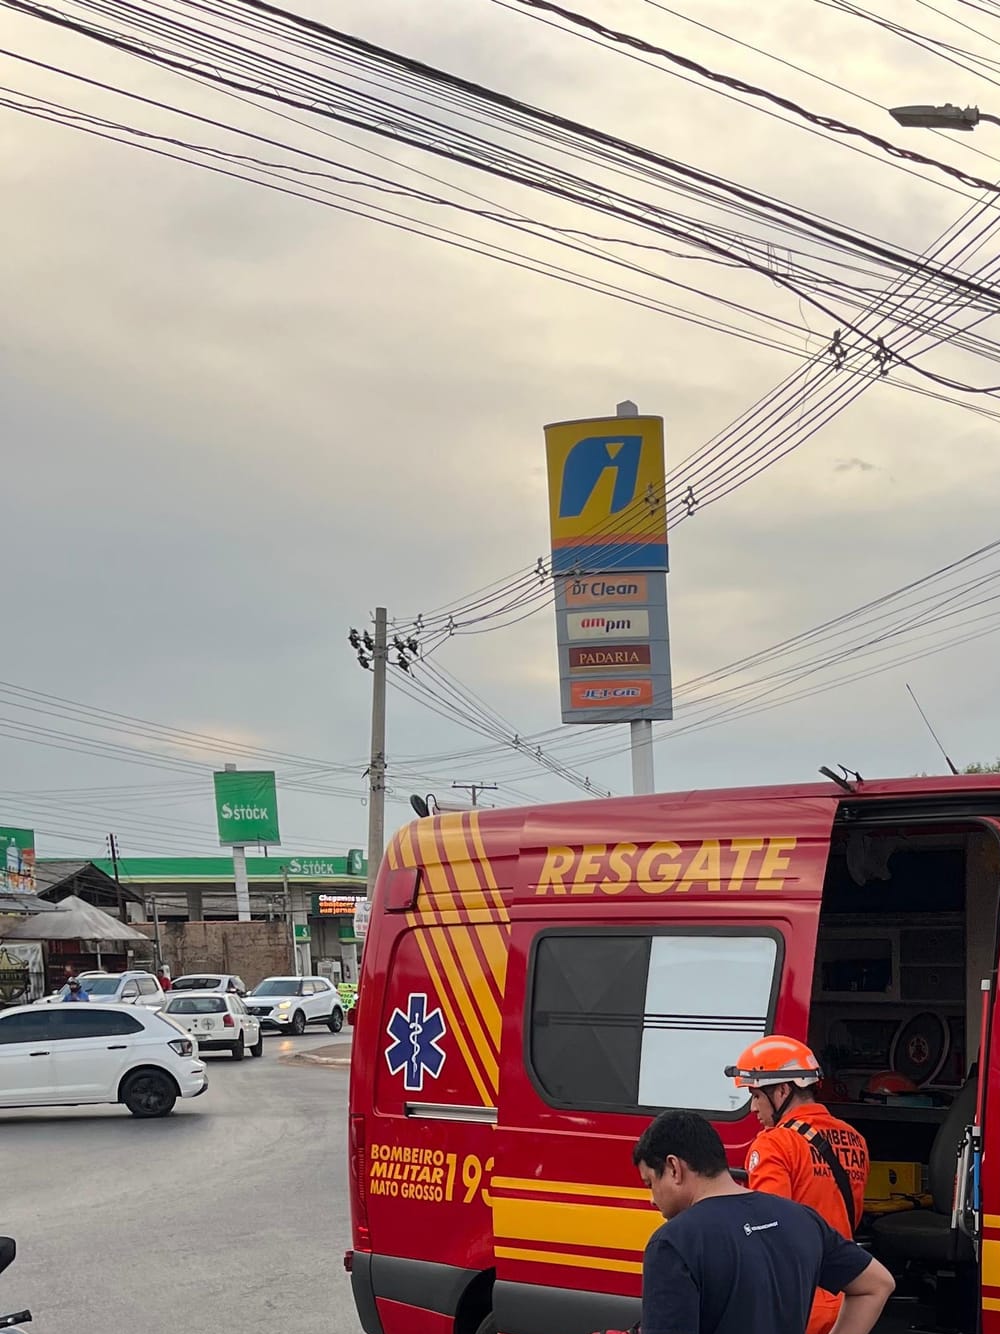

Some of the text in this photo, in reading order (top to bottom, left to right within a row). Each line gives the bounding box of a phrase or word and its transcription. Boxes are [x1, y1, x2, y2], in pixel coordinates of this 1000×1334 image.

[591, 582, 638, 596] Clean
[580, 651, 640, 664] PADARIA
[233, 807, 269, 820] STOCK
[302, 863, 334, 874] STOCK
[535, 837, 797, 895] RESGATE
[371, 1144, 445, 1166] BOMBEIRO
[370, 1161, 444, 1184] MILITAR
[370, 1179, 443, 1202] MATO GROSSO
